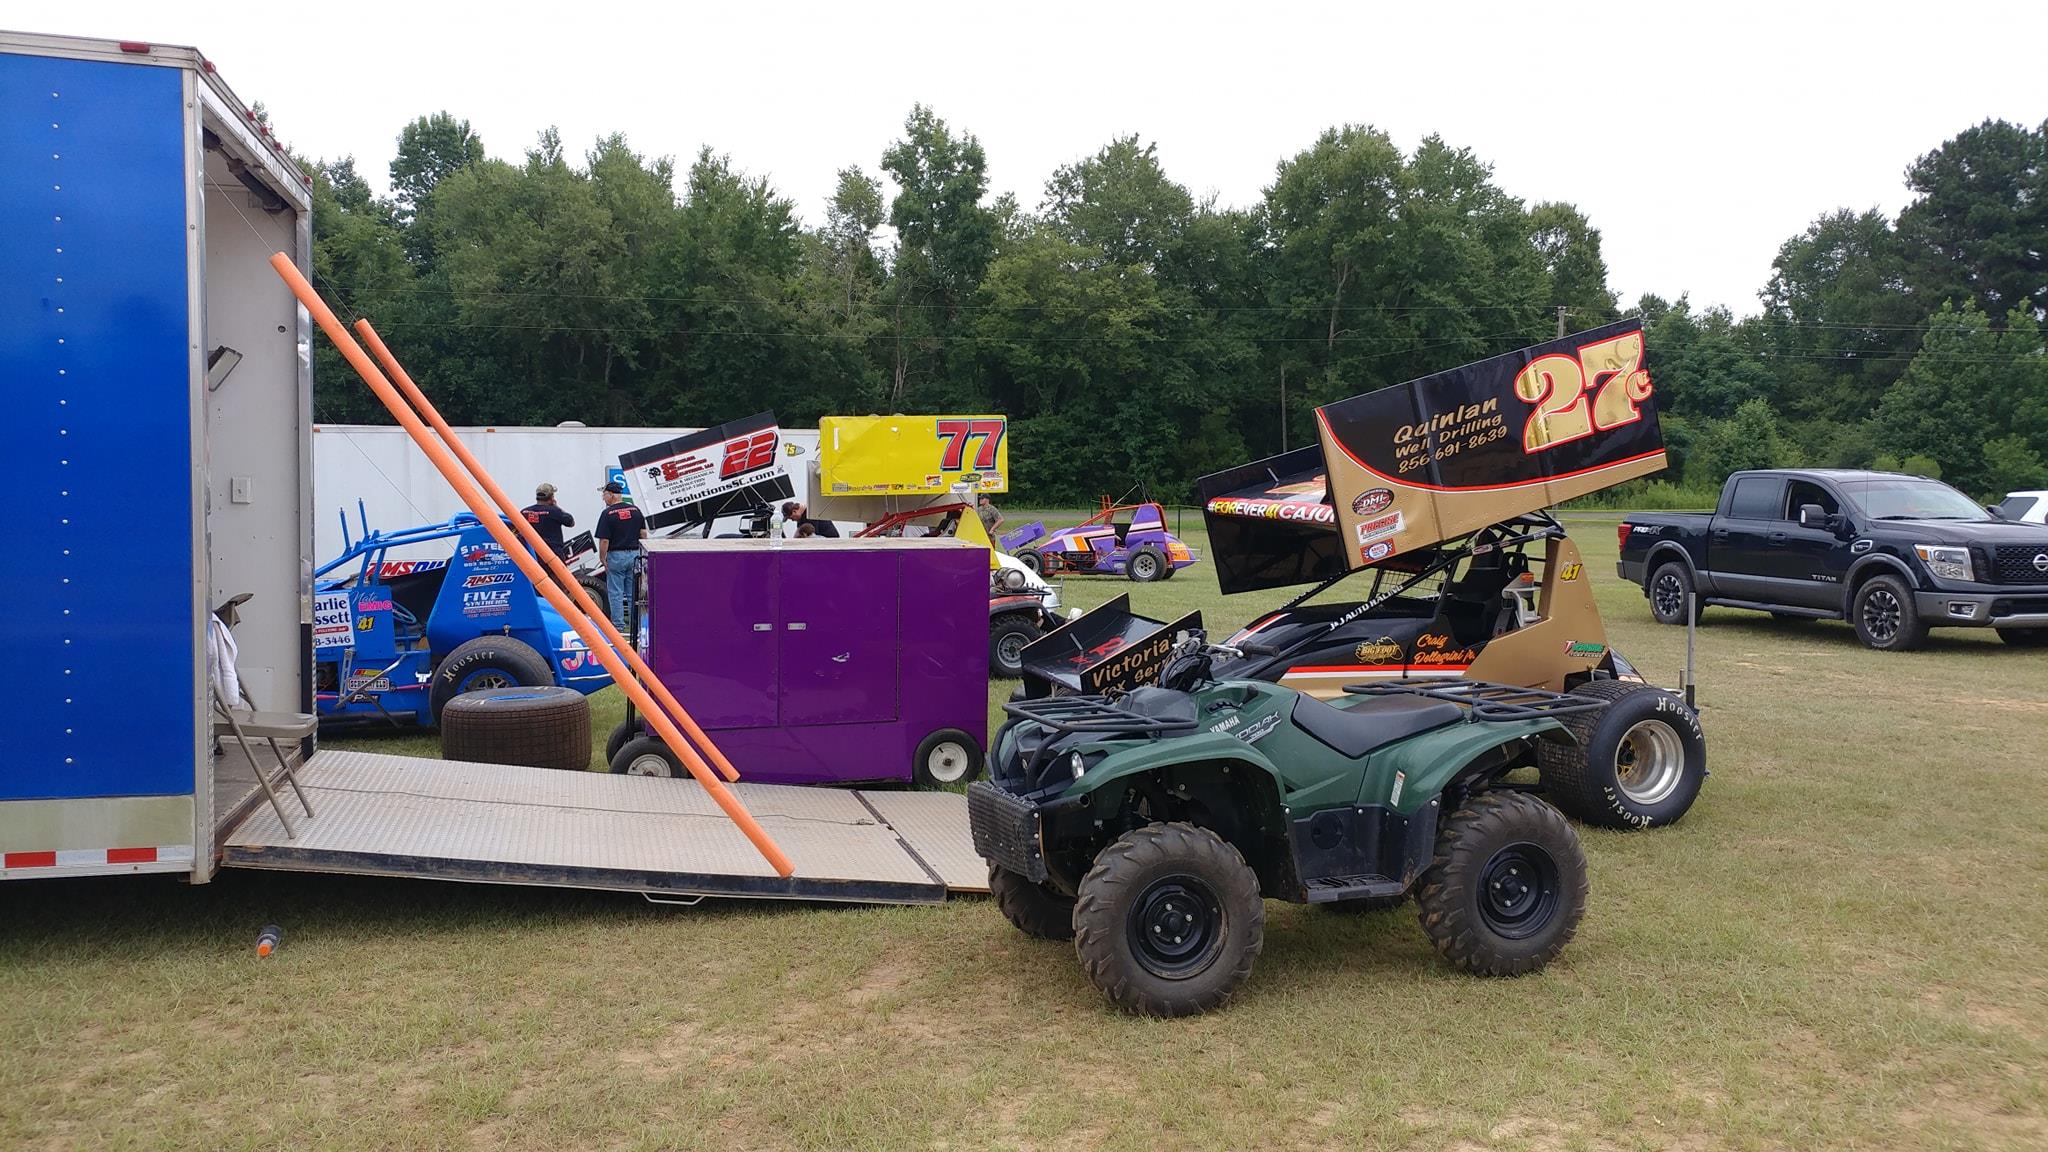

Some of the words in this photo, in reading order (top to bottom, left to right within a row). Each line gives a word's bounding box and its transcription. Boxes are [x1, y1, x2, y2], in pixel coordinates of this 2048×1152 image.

[1394, 398, 1497, 443] Quinlan
[937, 419, 1005, 470] 77
[1396, 437, 1430, 458] Well
[1440, 414, 1502, 443] Drilling
[719, 431, 779, 481] 22
[1399, 426, 1507, 473] 856-691-8639
[661, 470, 775, 509] CCSolutionsSC.com
[1207, 500, 1281, 519] #FOREVER41
[1280, 504, 1335, 522] CAJU
[462, 573, 514, 588] AMSOIL
[1561, 563, 1583, 581] 41
[315, 597, 347, 611] arlie
[1345, 603, 1371, 622] AUTO
[315, 611, 350, 626] ssett
[357, 616, 375, 631] 41
[315, 635, 351, 646] 8-3446
[1416, 634, 1448, 649] Craig
[443, 650, 495, 682] Hoosier
[1092, 633, 1172, 688] Victoria'
[1413, 650, 1465, 666] Pellegrini
[1209, 715, 1241, 733] YAMAHA
[1656, 696, 1702, 740] Hoosier
[1604, 786, 1653, 829] Hoosier
